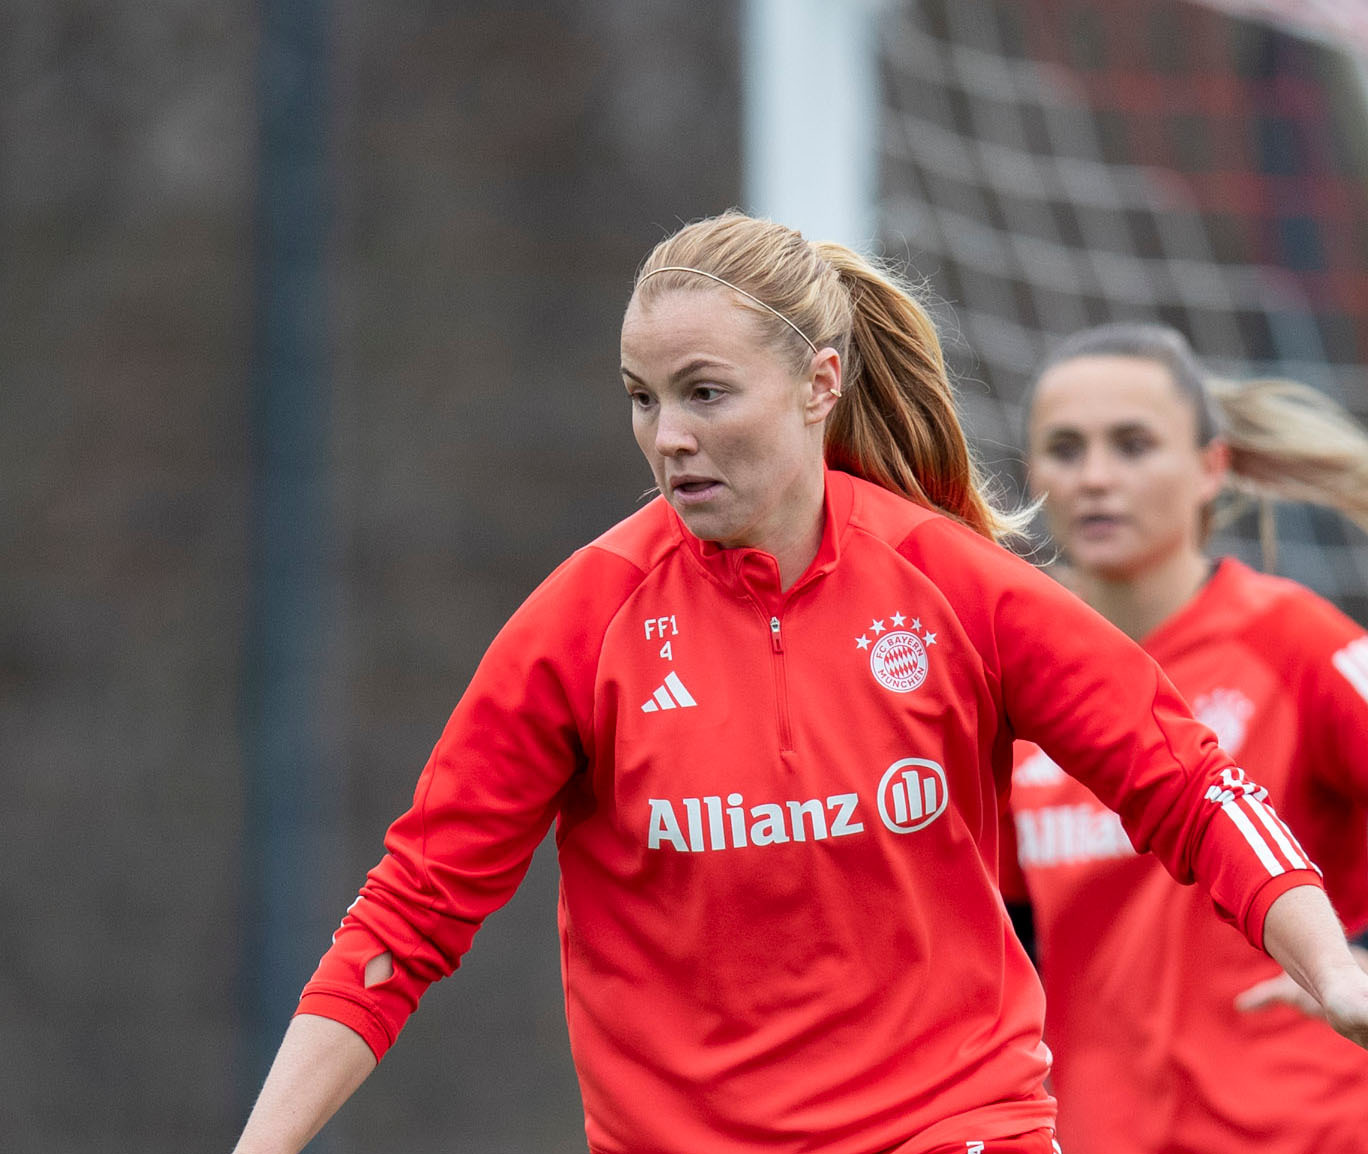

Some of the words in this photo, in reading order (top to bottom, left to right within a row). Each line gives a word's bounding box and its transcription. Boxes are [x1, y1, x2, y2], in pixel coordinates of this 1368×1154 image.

[644, 614, 679, 641] FF1
[659, 640, 673, 662] 4
[876, 645, 887, 660] FC
[887, 636, 924, 657] BAYERN
[648, 792, 864, 852] Allianz
